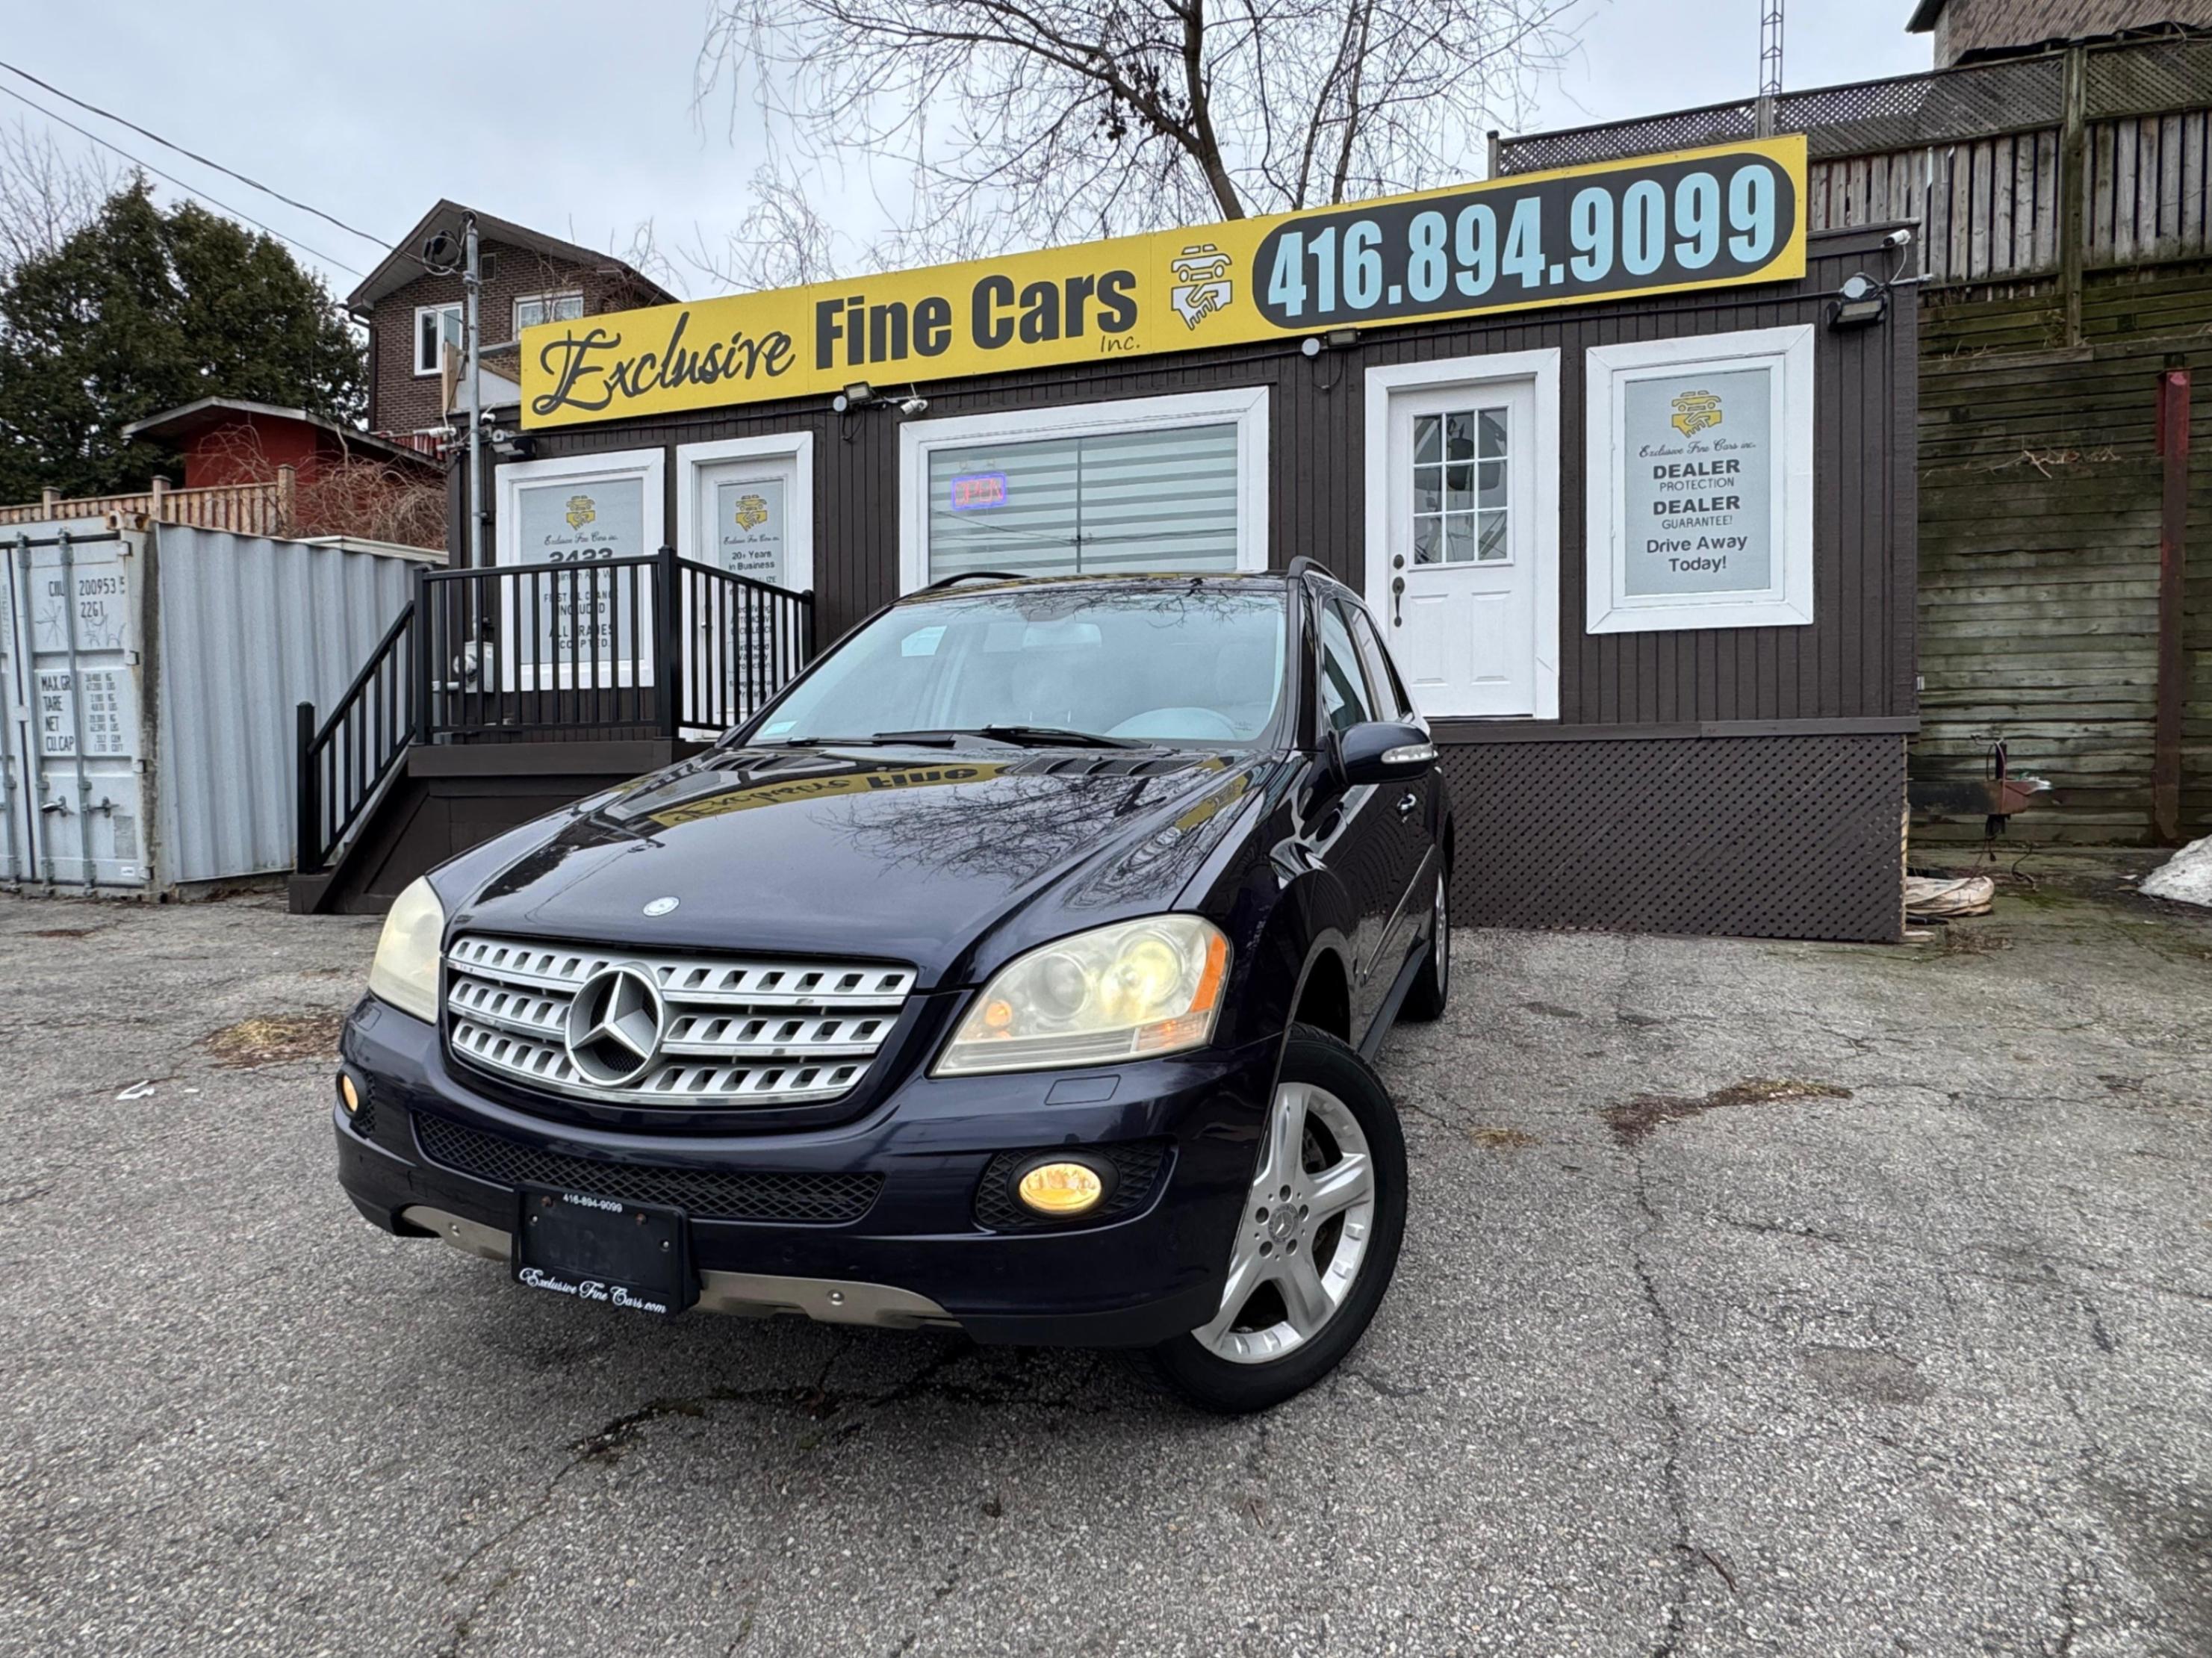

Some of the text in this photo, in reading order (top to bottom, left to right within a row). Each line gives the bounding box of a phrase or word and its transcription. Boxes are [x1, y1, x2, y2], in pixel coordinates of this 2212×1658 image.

[1267, 164, 1776, 317] 416.894.9099
[532, 270, 1138, 416] Exclusive Fine Cars
[1100, 335, 1140, 353] Inc.
[1638, 444, 1683, 458] Exclusive
[1688, 440, 1709, 454] Fine
[1713, 438, 1738, 452] Cars
[1653, 459, 1741, 479] DEALER
[956, 478, 1004, 506] OPEN
[1659, 477, 1735, 492] PROTECTION
[1653, 495, 1741, 515] DEALER
[1661, 515, 1733, 530] GUARANTEE!
[1647, 535, 1748, 553] Drive Away
[748, 550, 771, 559] Years
[737, 561, 775, 571] Business
[1668, 556, 1727, 573] Today!
[79, 578, 116, 596] 200953
[81, 600, 104, 618] 22G1
[43, 695, 63, 712] TARE
[45, 715, 59, 732] NET
[563, 1193, 623, 1213] 416-894-9099
[519, 1267, 577, 1294] Exclusive
[579, 1280, 609, 1302] Fine
